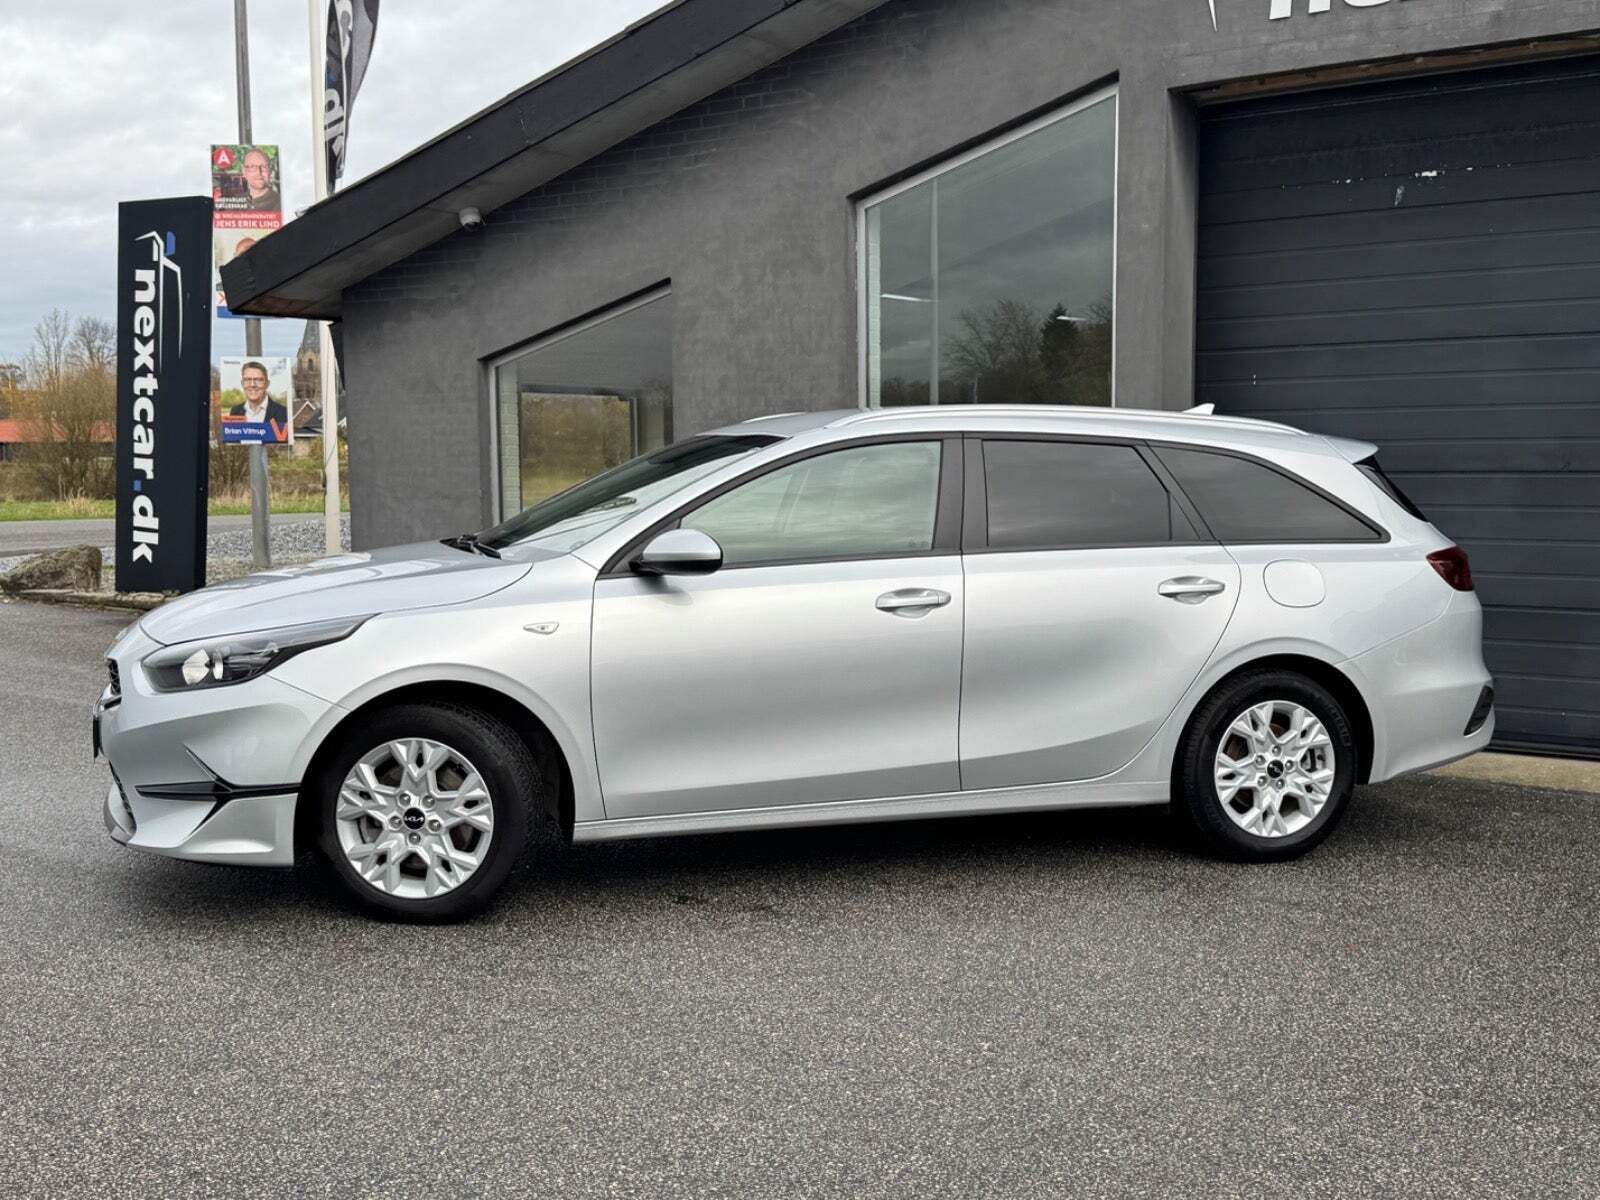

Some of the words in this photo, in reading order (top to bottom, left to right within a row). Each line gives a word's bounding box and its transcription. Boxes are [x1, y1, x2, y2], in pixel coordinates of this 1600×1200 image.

[217, 149, 231, 164] A
[238, 220, 257, 228] ERIK
[259, 220, 280, 228] LIND
[132, 268, 160, 564] nextcar.dk
